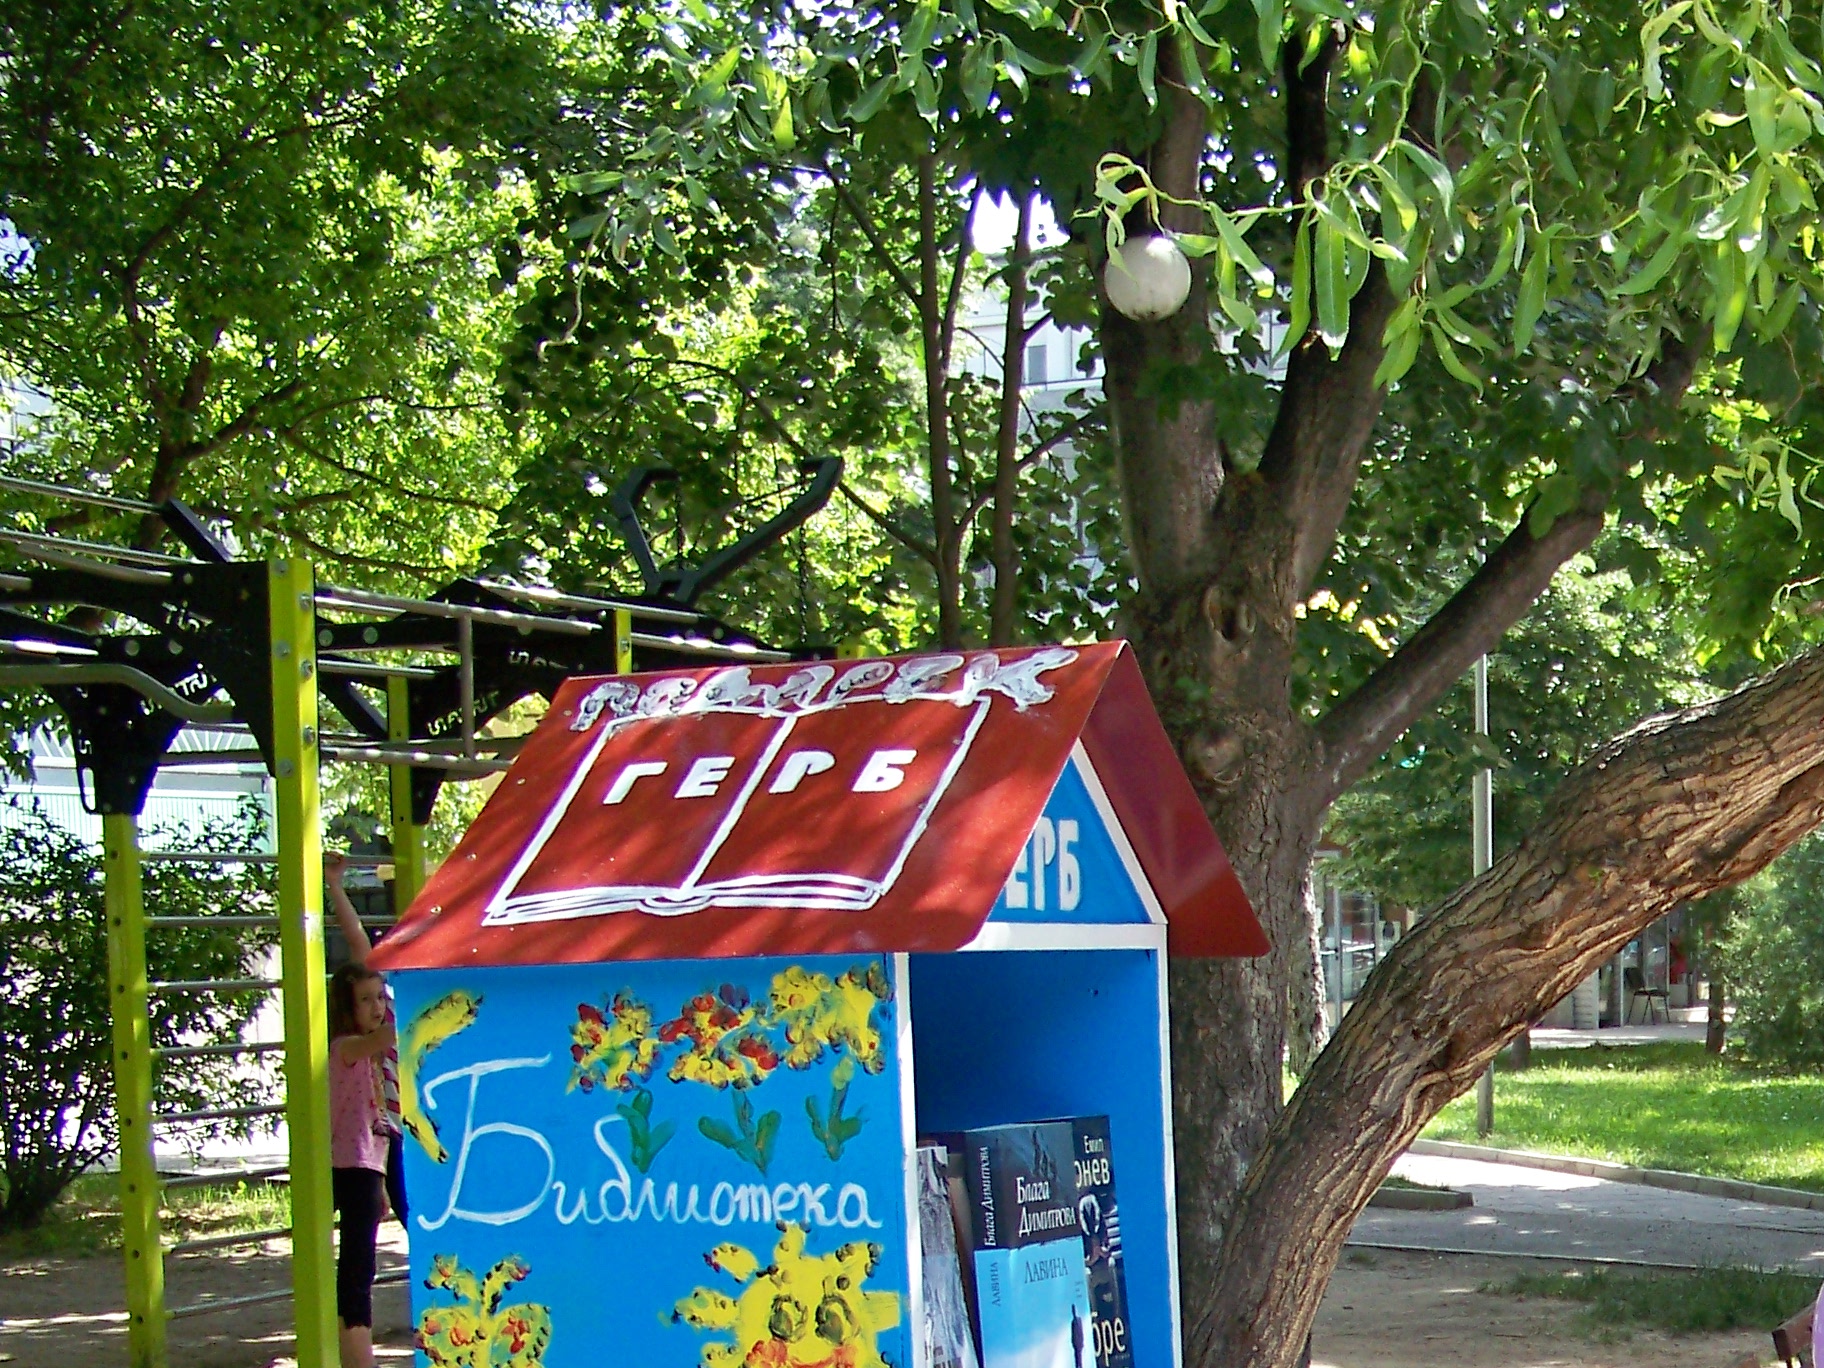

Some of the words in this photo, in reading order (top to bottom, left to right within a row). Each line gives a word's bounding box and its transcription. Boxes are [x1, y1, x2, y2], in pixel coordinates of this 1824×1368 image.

[603, 749, 918, 804] ГЕРБ
[1006, 815, 1080, 912] ЕРБ
[418, 1053, 883, 1231] Библиотека
[1016, 1176, 1051, 1205] Блага
[1074, 1158, 1111, 1188] онев
[1024, 1257, 1069, 1284] ЛАВИНА
